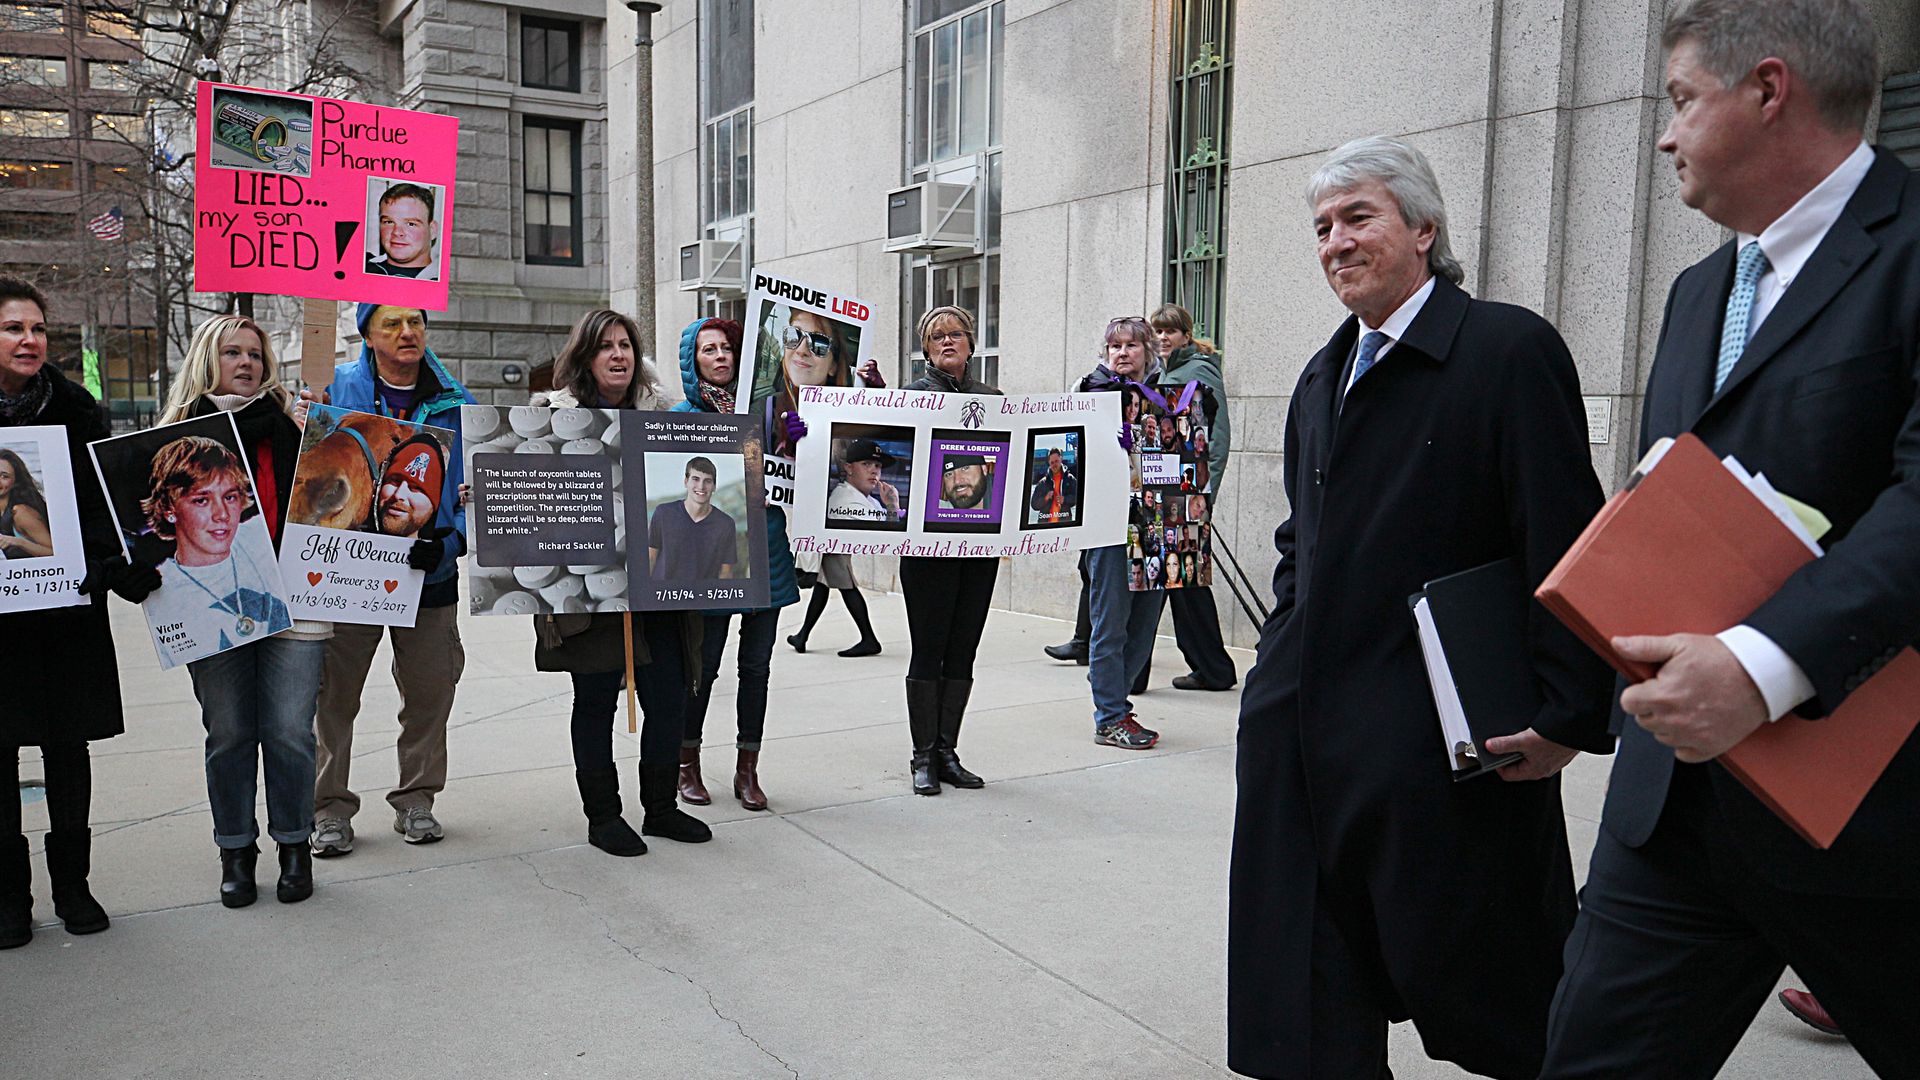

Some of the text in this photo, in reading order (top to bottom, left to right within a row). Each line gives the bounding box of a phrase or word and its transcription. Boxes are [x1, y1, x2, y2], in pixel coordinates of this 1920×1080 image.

[322, 102, 408, 144] Purdue
[321, 140, 415, 174] Pharma
[234, 172, 328, 207] LIED...
[200, 211, 302, 238] my son
[230, 231, 318, 270] DIED
[754, 274, 870, 322] PURDUE LIED
[800, 386, 845, 407] They
[848, 389, 908, 408] should
[911, 393, 946, 410] still
[1000, 398, 1018, 414] be
[1021, 397, 1048, 414] here
[1050, 395, 1074, 412] with
[644, 422, 664, 431] Sadly
[673, 422, 694, 431] buried
[710, 423, 738, 432] children
[538, 470, 574, 479] oxycontin
[548, 482, 557, 490] by
[486, 493, 537, 501] prescriptions
[572, 493, 588, 501] bury
[487, 504, 537, 512] competition.
[555, 504, 603, 513] prescription
[829, 506, 865, 516] Michael
[558, 515, 578, 524] deep,
[580, 515, 604, 524] dense,
[300, 534, 341, 563] Jeff
[842, 543, 890, 554] never
[893, 539, 951, 557] should
[958, 540, 995, 557] have
[6, 568, 64, 580] Johnson
[327, 571, 380, 590] Forever 33
[36, 579, 80, 594] 1/3/15
[291, 590, 347, 609] 11/13/1983
[361, 596, 408, 614] 2/5/2017
[656, 589, 694, 601] 7/15/94
[707, 588, 744, 600] 5/23/15
[156, 622, 183, 634] Victor
[159, 632, 186, 644] Veron
